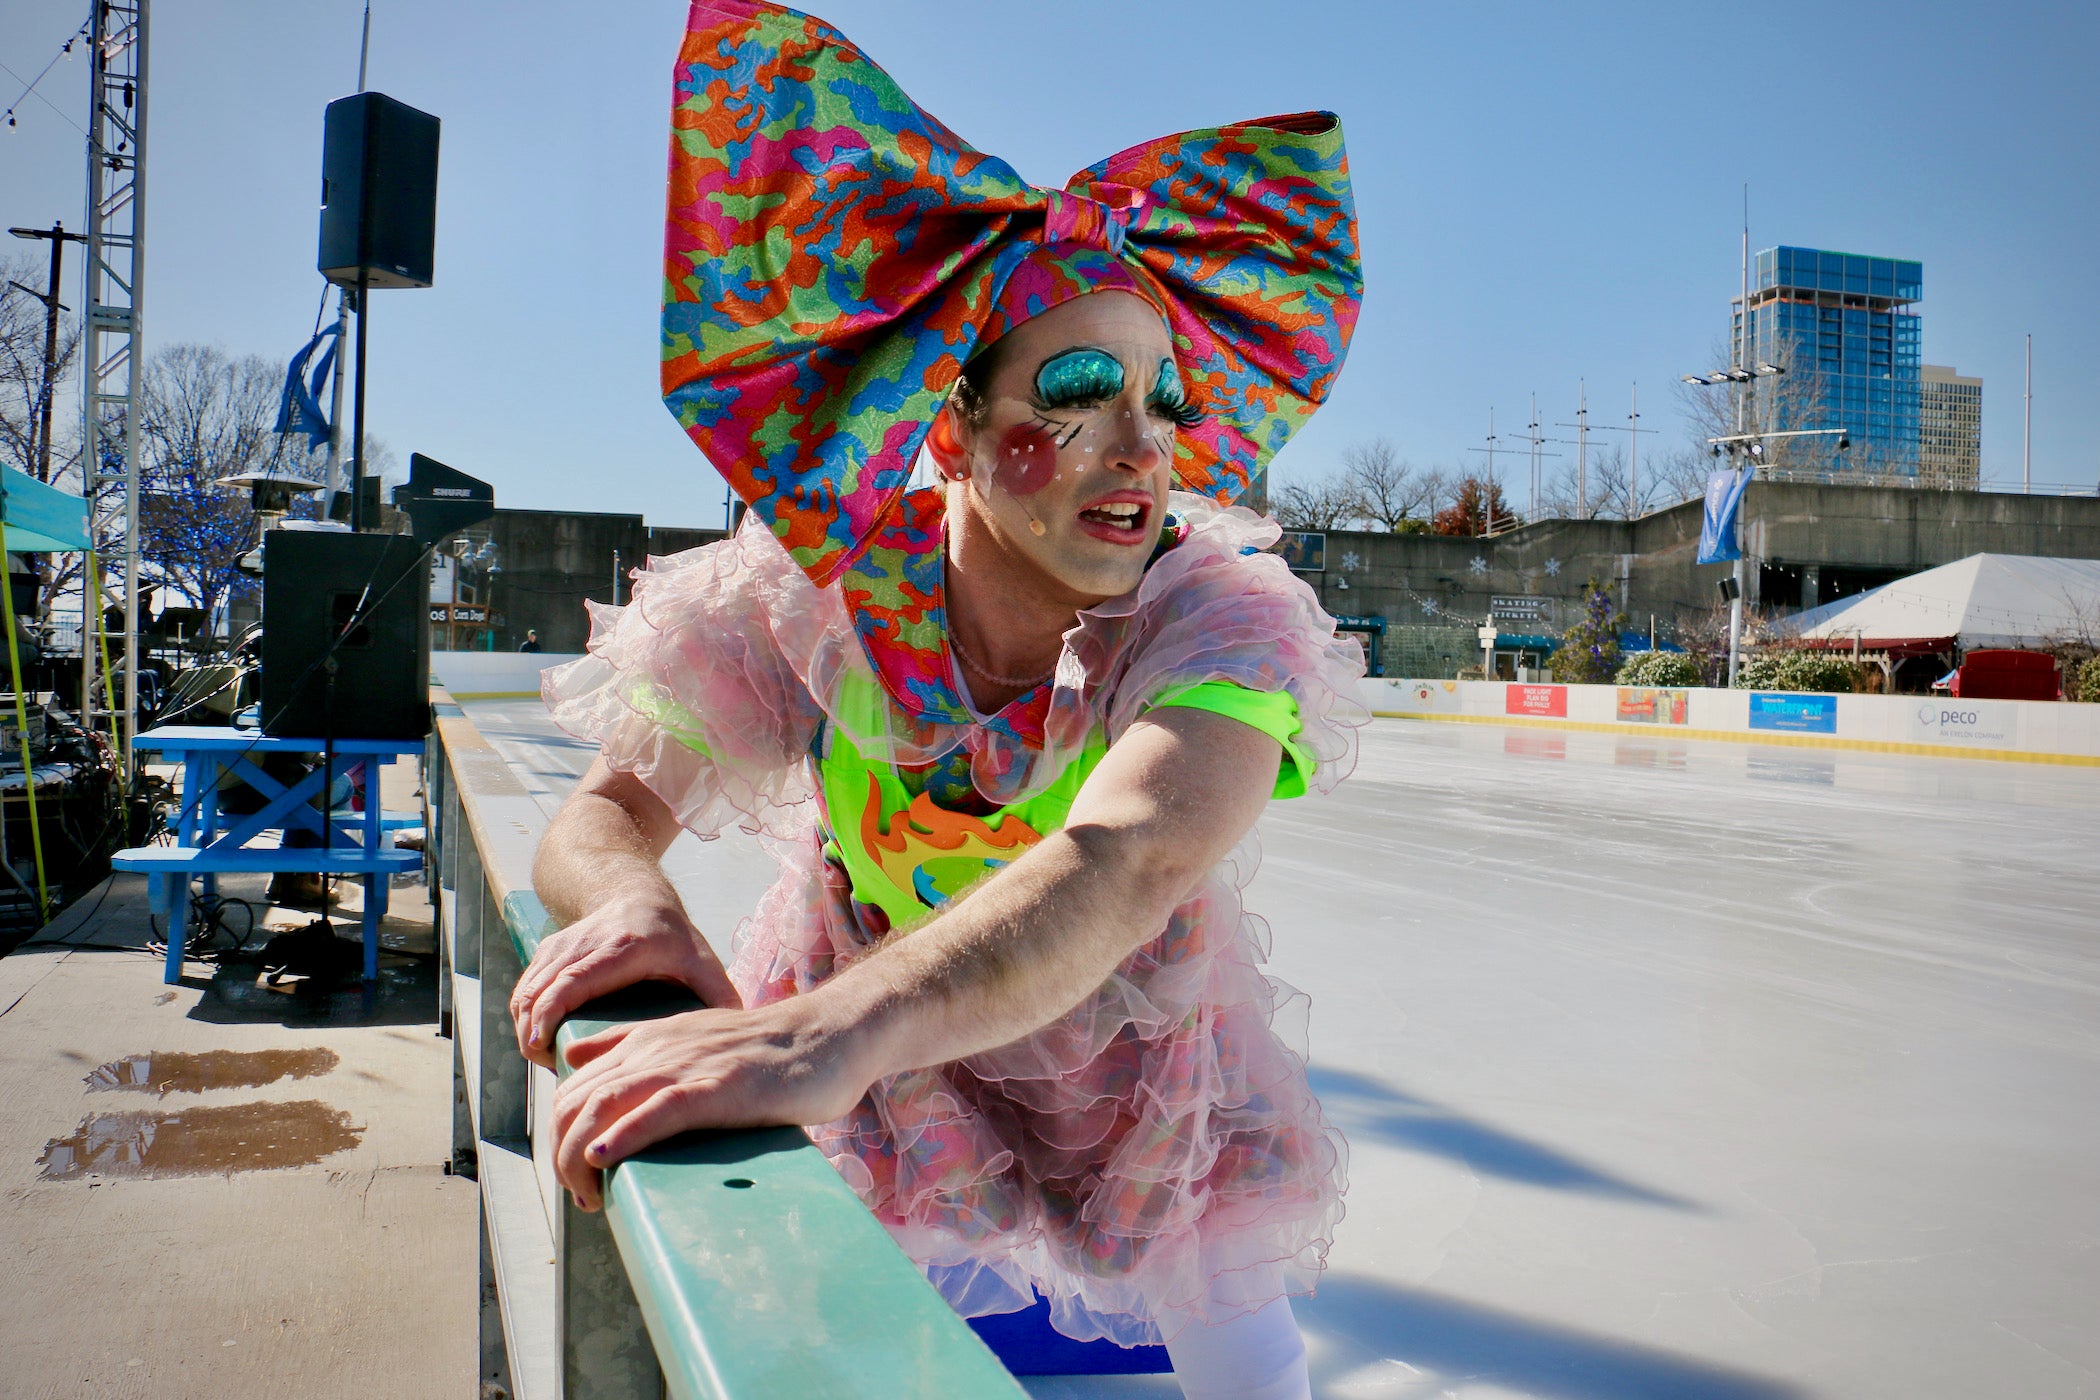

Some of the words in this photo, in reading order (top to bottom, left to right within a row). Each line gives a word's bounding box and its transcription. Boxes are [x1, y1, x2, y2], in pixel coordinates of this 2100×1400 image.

[432, 488, 472, 497] SHURE
[1493, 599, 1538, 607] SKATING
[453, 609, 469, 620] Corn
[1494, 611, 1538, 619] TICKETS
[1761, 702, 1824, 716] WATERFRONT
[1941, 711, 1977, 726] peco
[1974, 732, 2004, 740] COMPANY
